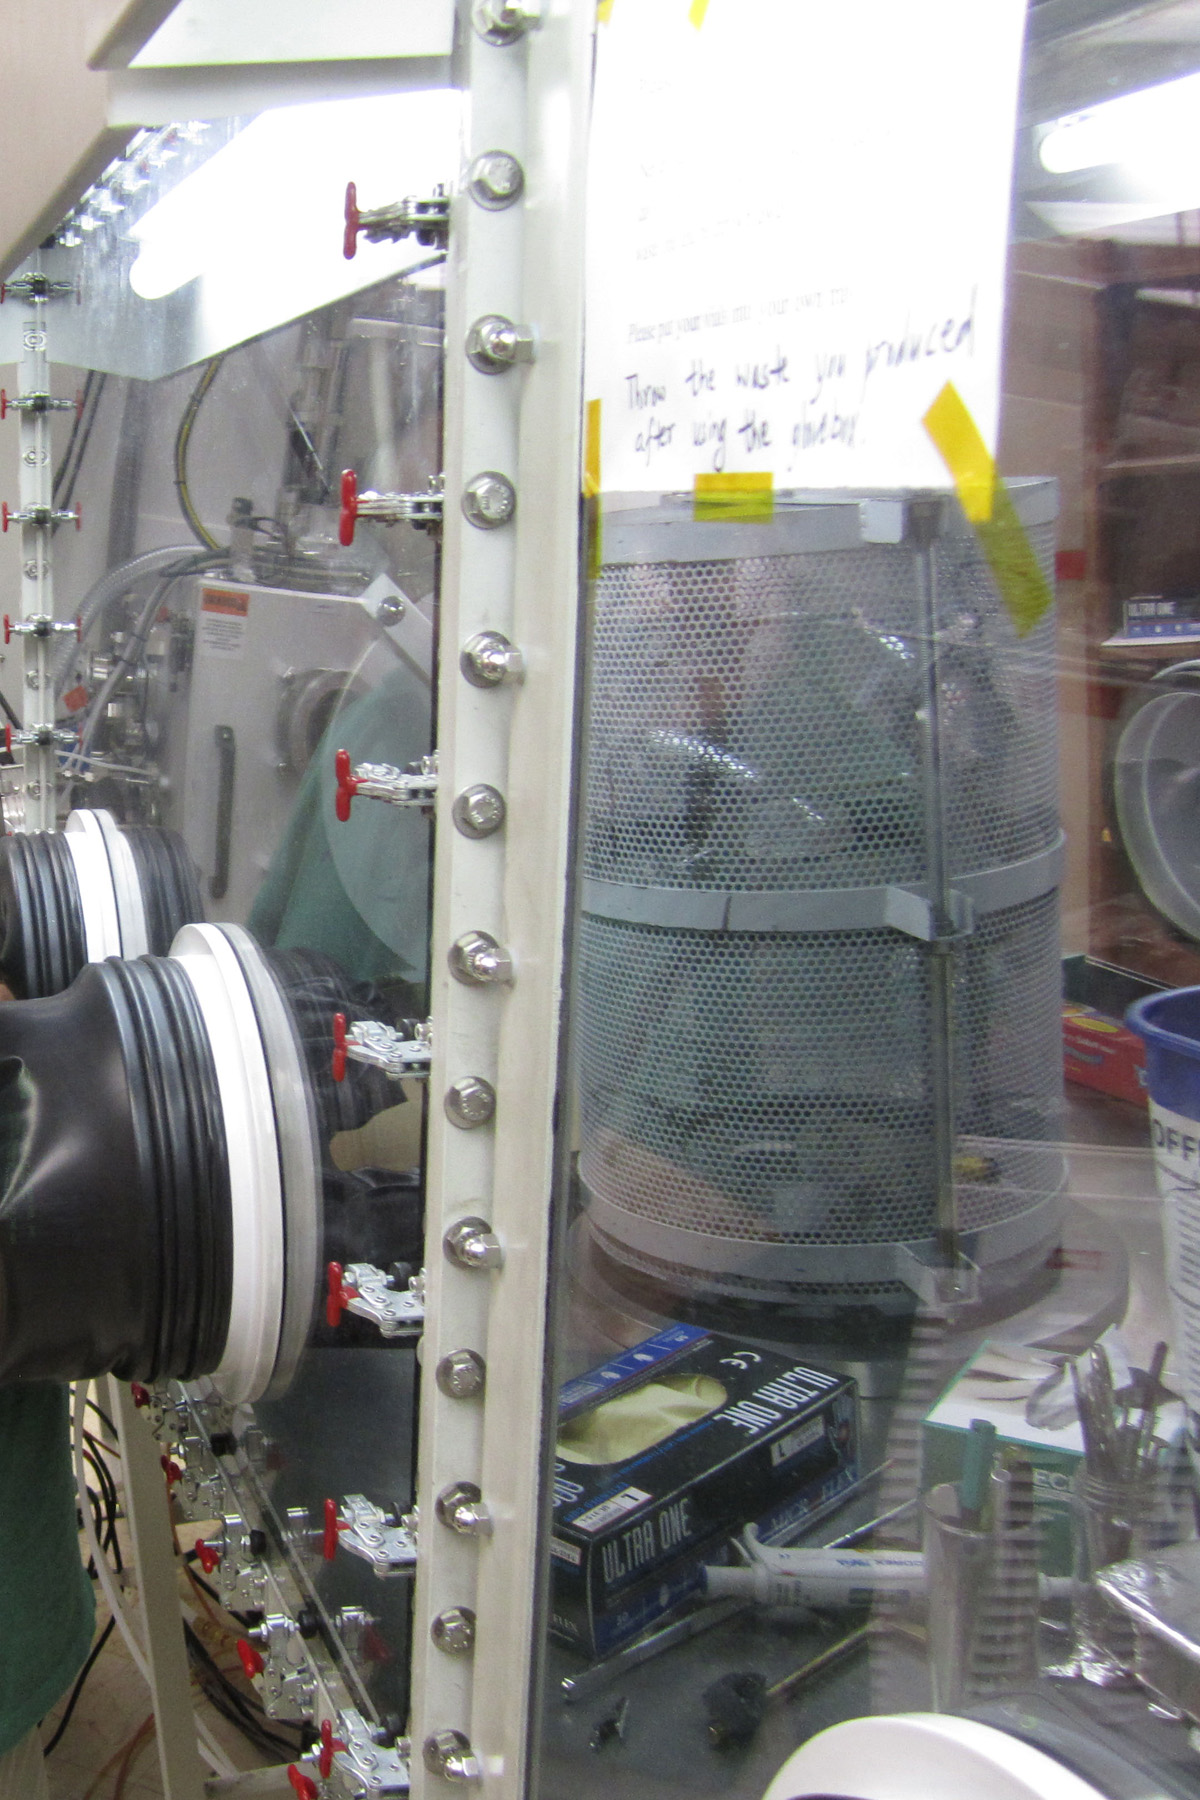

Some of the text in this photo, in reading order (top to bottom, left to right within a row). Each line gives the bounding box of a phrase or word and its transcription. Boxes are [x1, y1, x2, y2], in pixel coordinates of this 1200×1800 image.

[685, 358, 715, 397] the
[809, 352, 847, 405] you
[635, 415, 676, 467] after
[738, 408, 773, 453] the
[1153, 1118, 1200, 1161] OFF
[752, 1366, 840, 1410] ULTRA
[712, 1400, 782, 1435] ONE
[602, 1498, 692, 1584] ULTRA ONE
